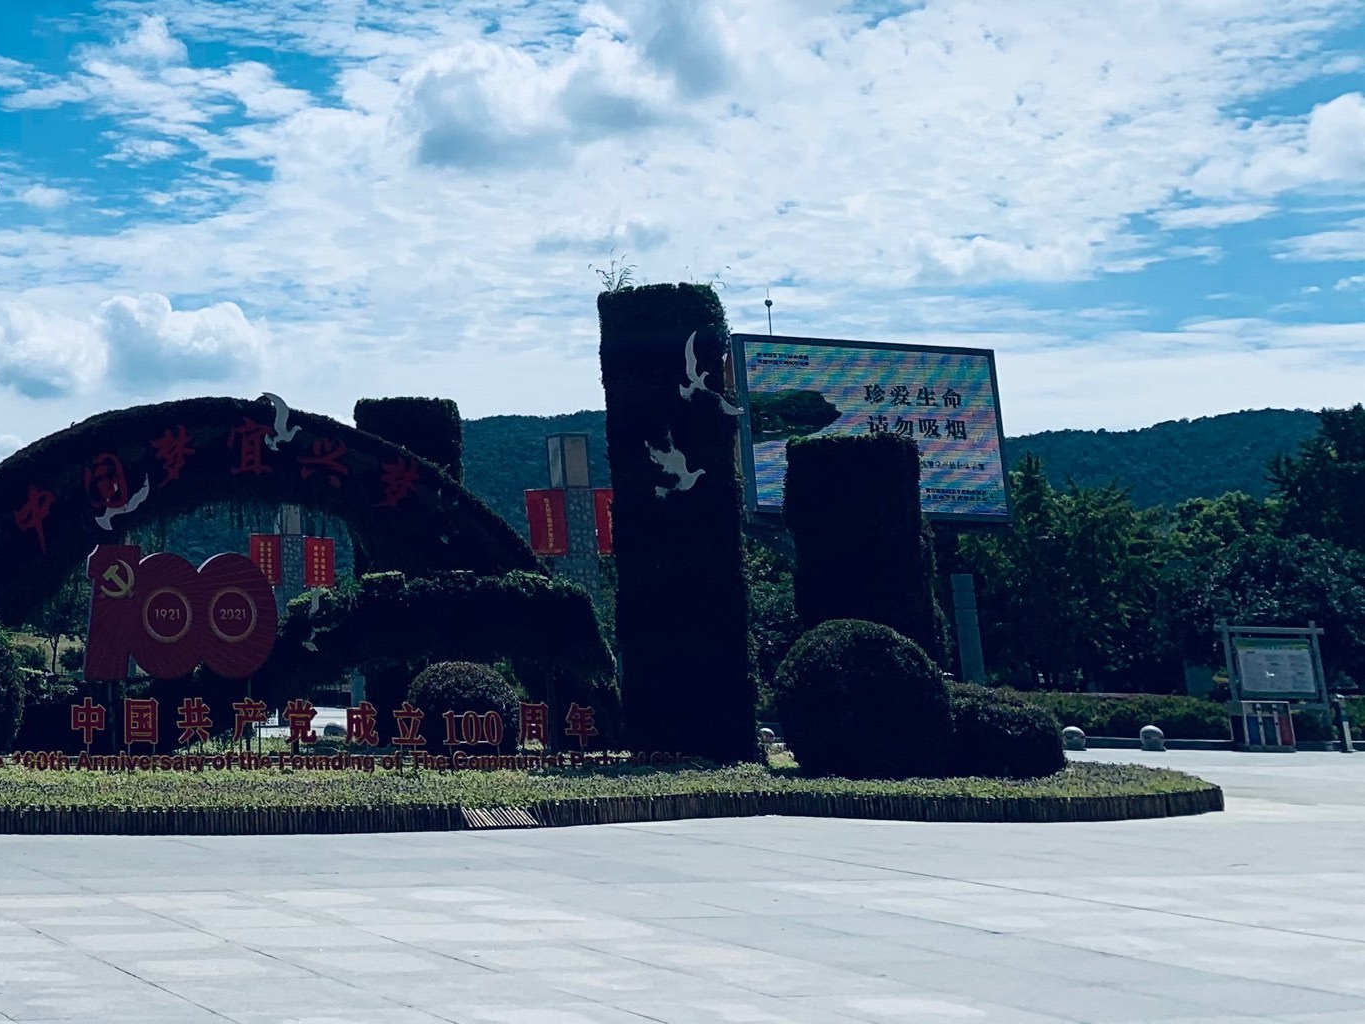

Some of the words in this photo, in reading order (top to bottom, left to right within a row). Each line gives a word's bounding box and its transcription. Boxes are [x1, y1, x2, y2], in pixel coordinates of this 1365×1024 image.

[864, 383, 963, 409] 珍爱生命
[867, 414, 967, 439] 请勿吸烟
[154, 607, 181, 621] 1921
[219, 607, 246, 621] 2021
[70, 697, 598, 748] 中国共产党成立100周年
[76, 750, 205, 772] Anniversary
[212, 751, 237, 771] of
[239, 751, 271, 771] the
[278, 751, 375, 776] Founding
[382, 750, 403, 772] of
[411, 750, 447, 770] The
[452, 750, 564, 770] Communist
